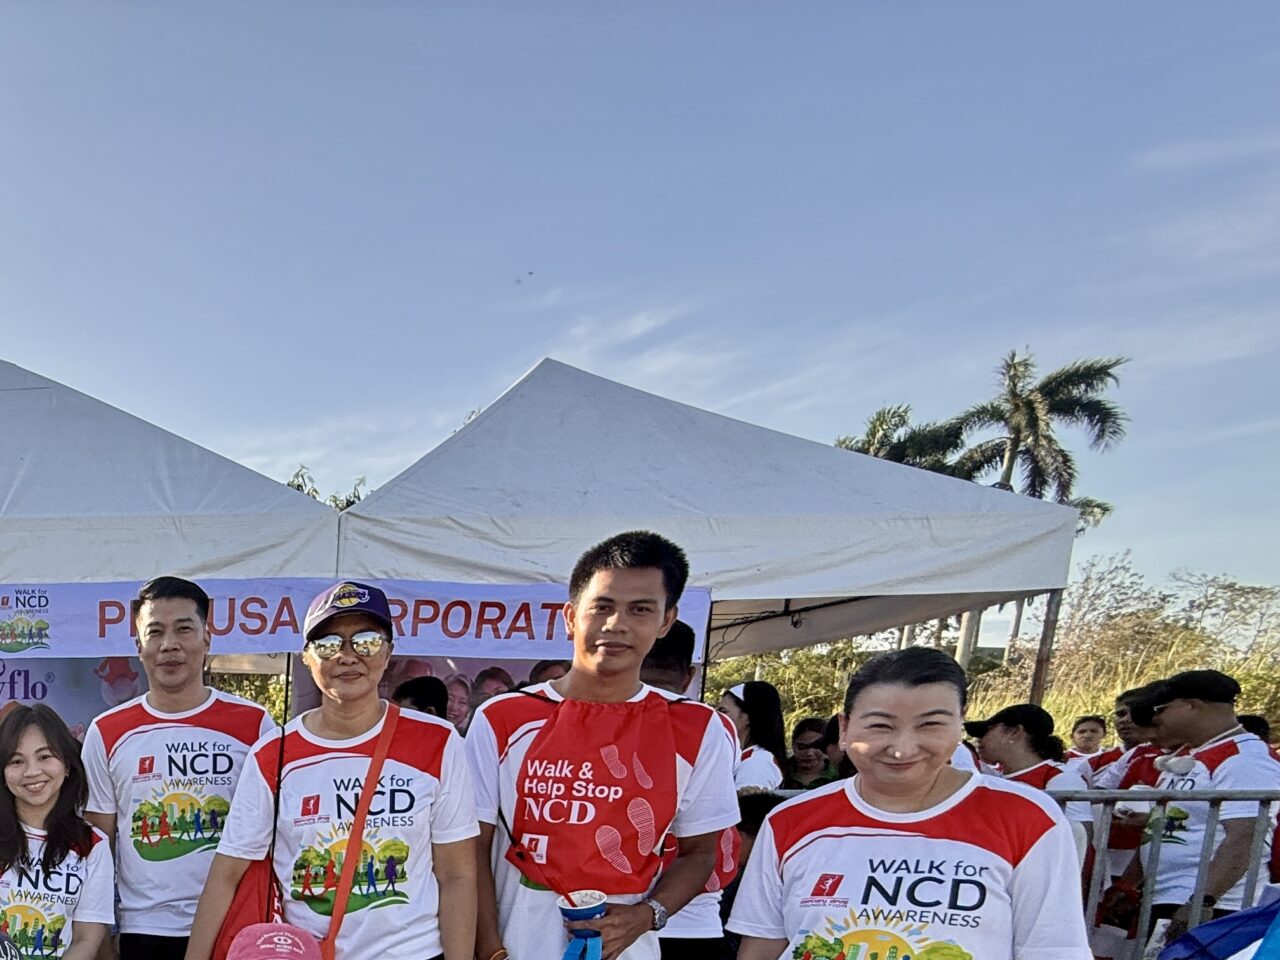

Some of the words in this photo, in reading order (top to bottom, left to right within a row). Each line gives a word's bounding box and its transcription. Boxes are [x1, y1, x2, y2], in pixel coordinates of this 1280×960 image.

[15, 596, 49, 608] NCD
[166, 742, 208, 753] WALK
[213, 742, 231, 752] for
[168, 753, 233, 776] NCD
[527, 760, 573, 778] Walk
[578, 762, 593, 780] &
[169, 777, 232, 787] AWARENESS
[390, 774, 413, 787] for
[524, 778, 565, 798] Help
[572, 781, 623, 802] Stop
[524, 797, 596, 825] NCD
[337, 816, 414, 832] AWRENESS
[868, 858, 947, 877] WALK
[954, 860, 990, 877] for
[18, 866, 82, 895] NCD
[860, 875, 987, 911] NCD
[857, 908, 983, 928] AWARENESS
